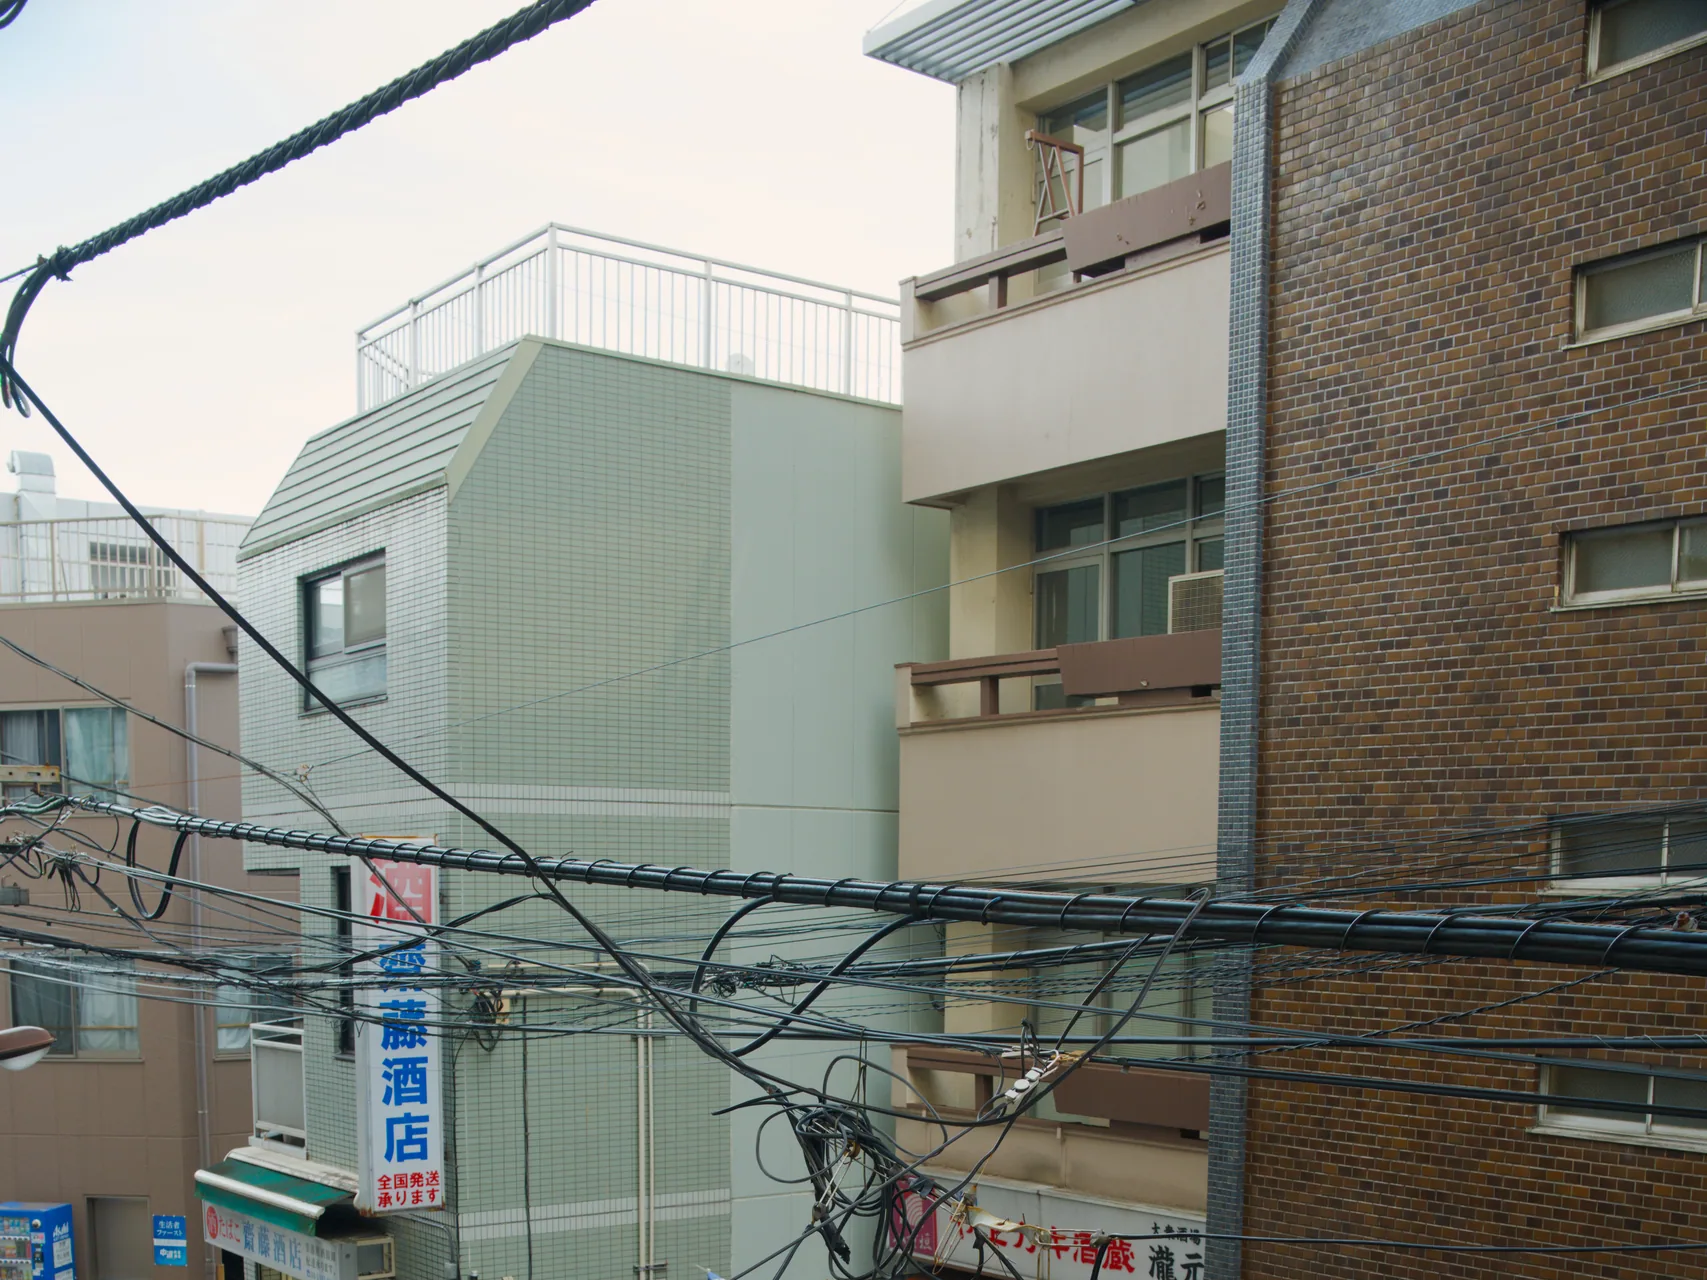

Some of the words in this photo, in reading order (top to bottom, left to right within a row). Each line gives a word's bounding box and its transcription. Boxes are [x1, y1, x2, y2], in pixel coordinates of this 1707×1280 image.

[377, 1170, 440, 1191] 全国発送
[377, 1188, 440, 1208] 承ります
[156, 1229, 183, 1237] ファースト
[158, 1220, 181, 1230] 生活者
[219, 1215, 241, 1243] たばこ
